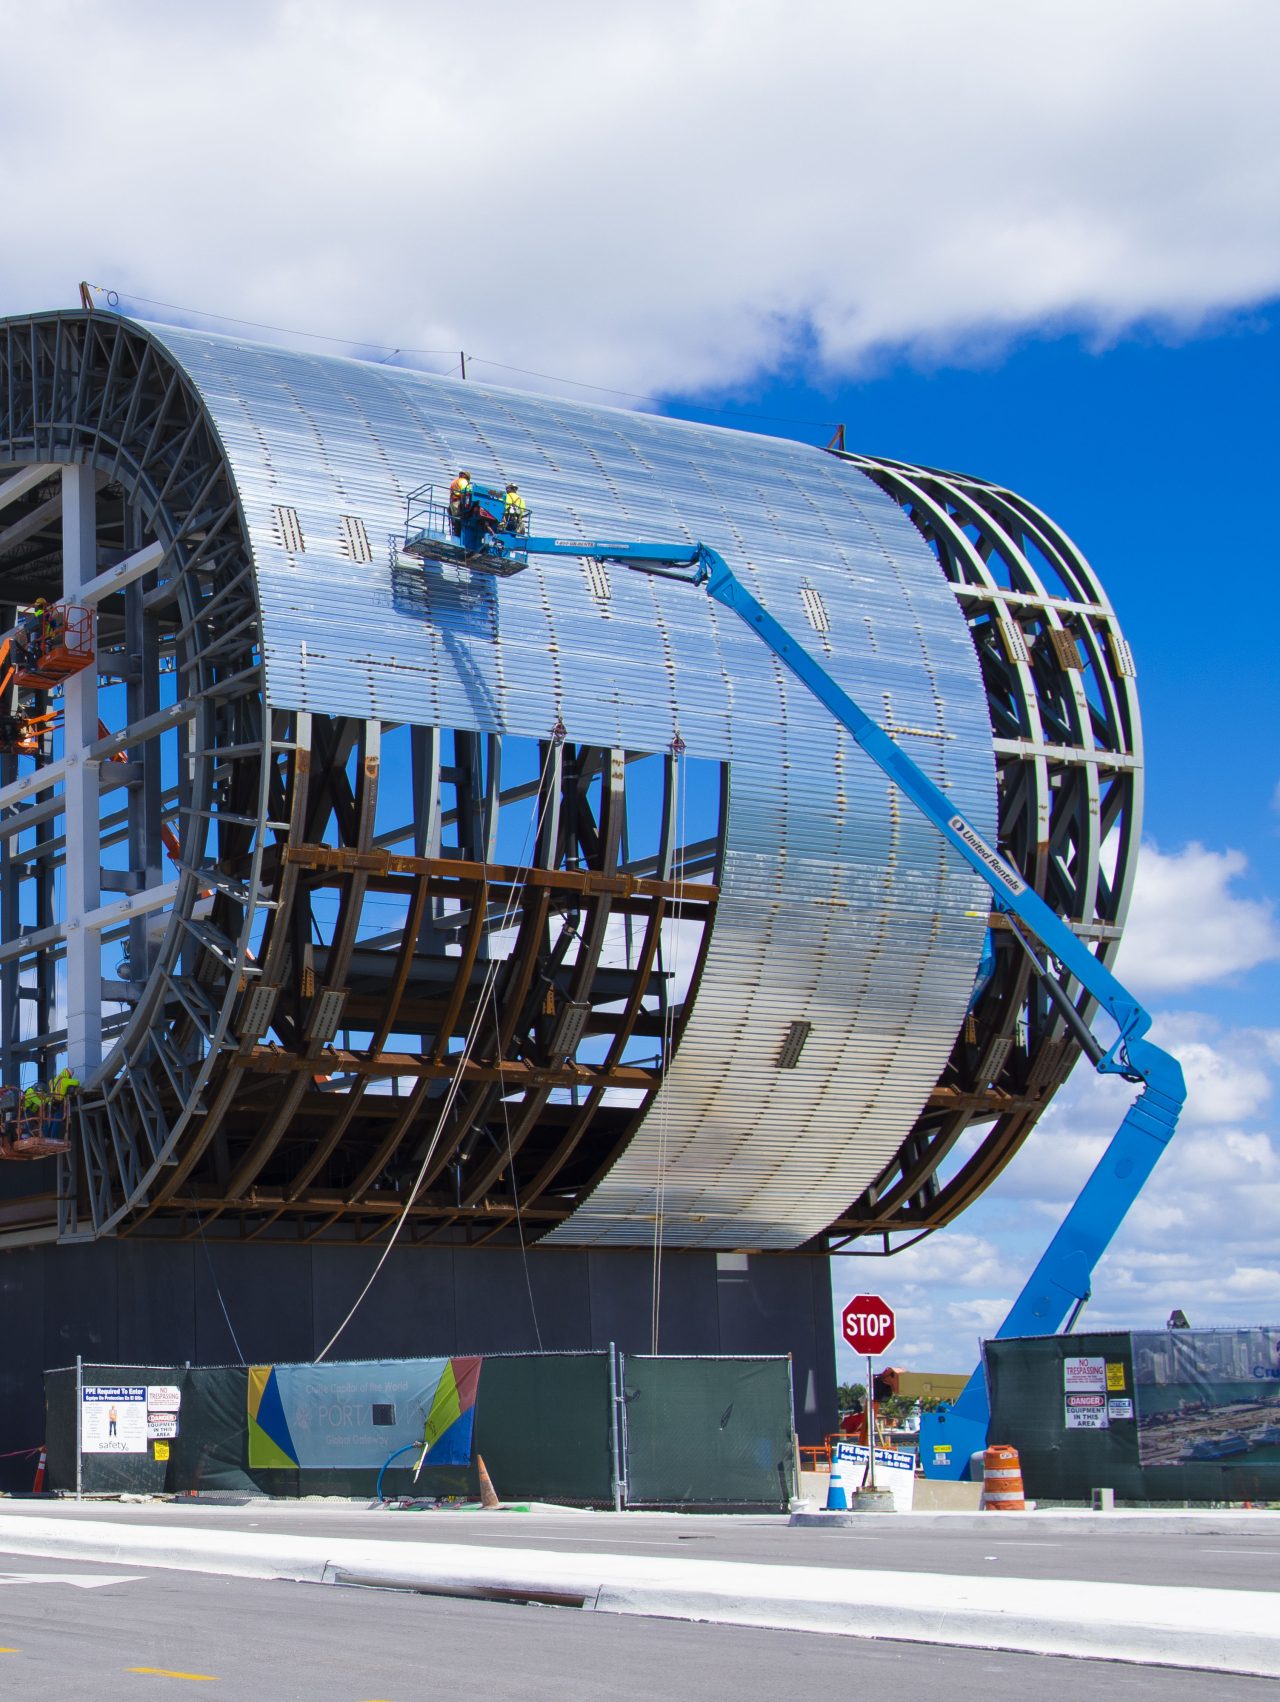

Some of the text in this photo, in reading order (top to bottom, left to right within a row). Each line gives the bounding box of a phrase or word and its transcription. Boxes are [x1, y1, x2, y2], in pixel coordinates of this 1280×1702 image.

[963, 830, 1020, 891] United Rentals
[846, 1313, 891, 1337] STOP
[1078, 1359, 1089, 1367] NO
[1067, 1366, 1104, 1375] TRESPASSING
[384, 1381, 408, 1392] World
[97, 1388, 120, 1396] Required
[1070, 1397, 1100, 1405] DANGER
[99, 1440, 126, 1450] safety
[841, 1445, 854, 1454] PPE
[884, 1451, 893, 1460] To
[893, 1453, 911, 1462] Enter
